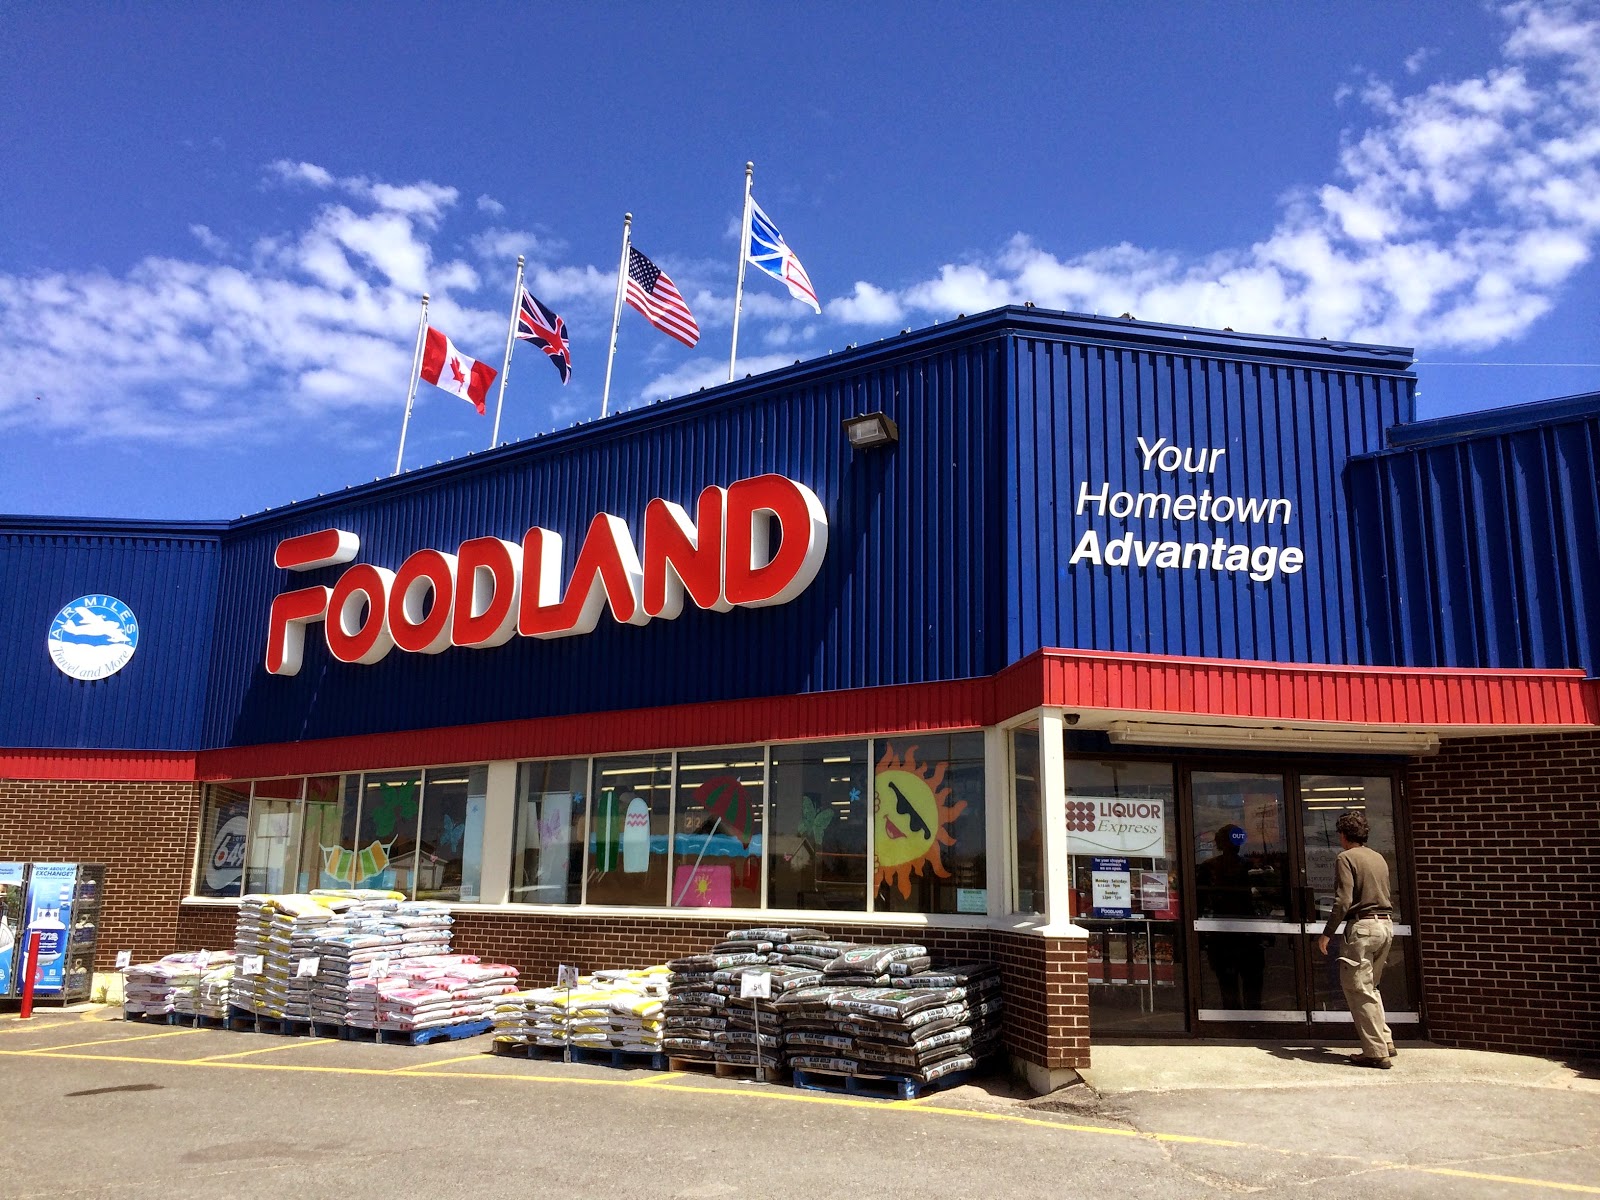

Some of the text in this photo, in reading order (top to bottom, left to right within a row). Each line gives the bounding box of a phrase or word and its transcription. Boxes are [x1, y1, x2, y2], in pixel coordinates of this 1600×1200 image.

[1136, 436, 1226, 474] Your
[1075, 481, 1292, 525] Hometown
[265, 473, 828, 677] FOODLAND
[1068, 529, 1304, 582] Advantage
[51, 596, 137, 640] AIR MILES
[52, 645, 130, 678] Travel and More
[1097, 819, 1158, 836] Express
[1099, 802, 1161, 819] LIQUOR
